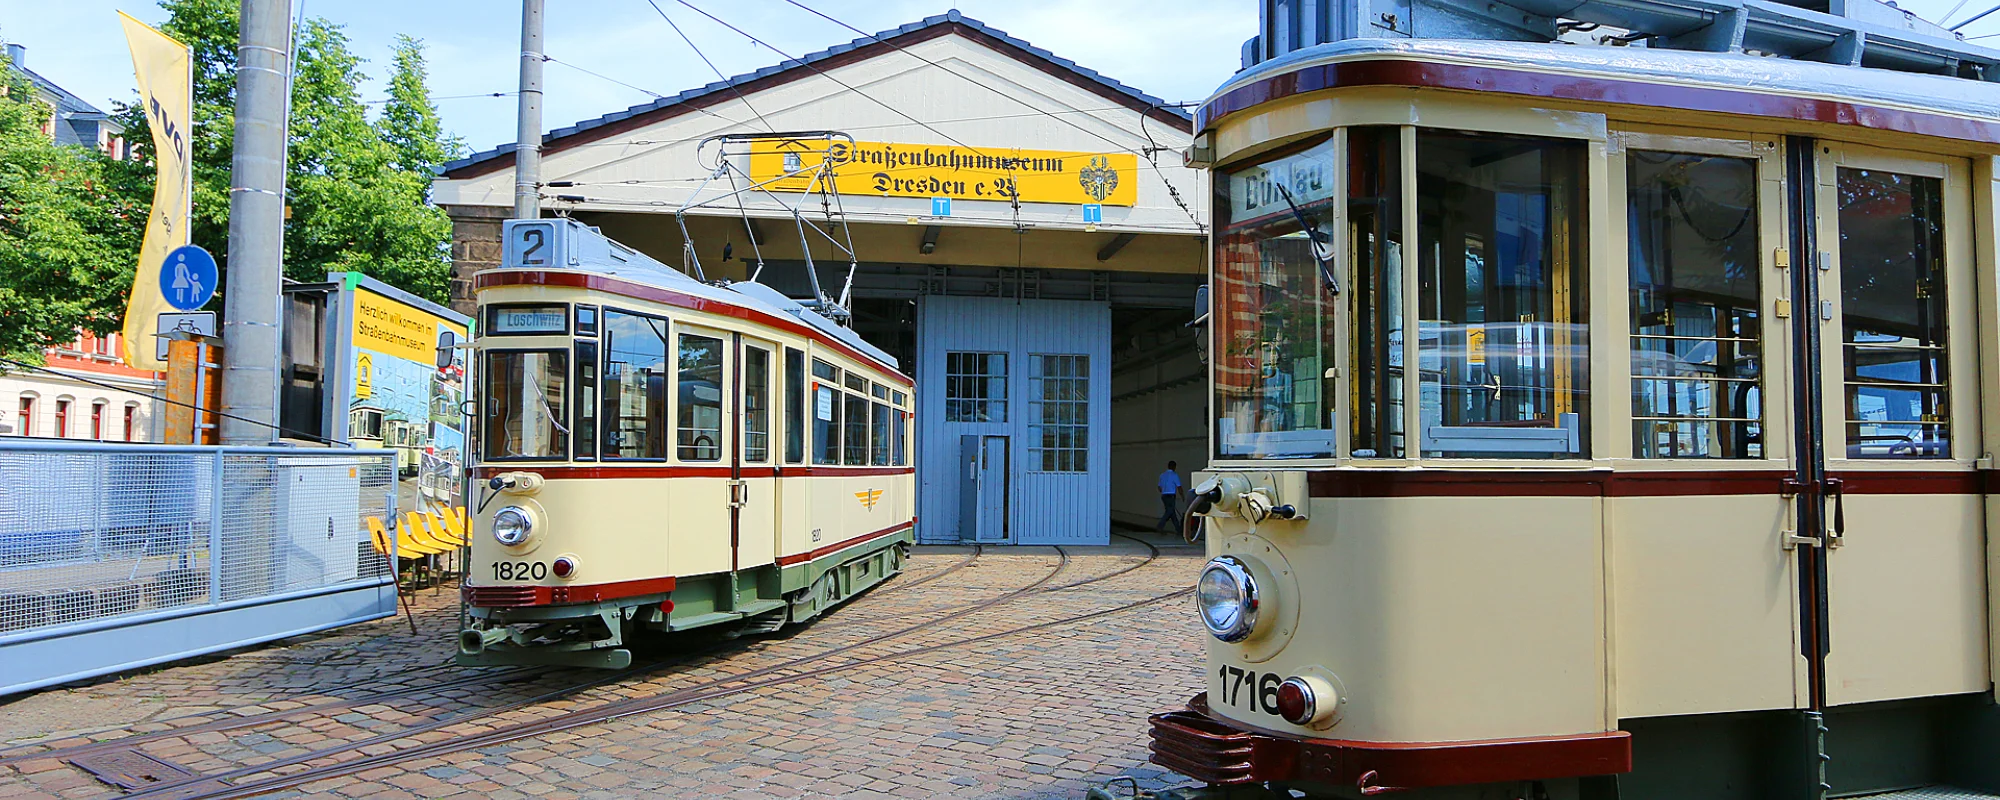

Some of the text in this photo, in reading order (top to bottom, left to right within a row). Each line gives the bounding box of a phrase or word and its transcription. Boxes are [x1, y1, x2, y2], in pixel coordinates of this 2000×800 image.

[872, 172, 966, 195] Dresden
[523, 229, 545, 265] 2
[360, 300, 388, 321] Herzlich
[389, 312, 425, 334] willkommen
[425, 322, 433, 336] im
[507, 309, 561, 327] Loschwitz
[358, 320, 426, 352] Straßenbahnmuseum
[491, 561, 548, 581] 1820
[1219, 664, 1284, 716] 1716
